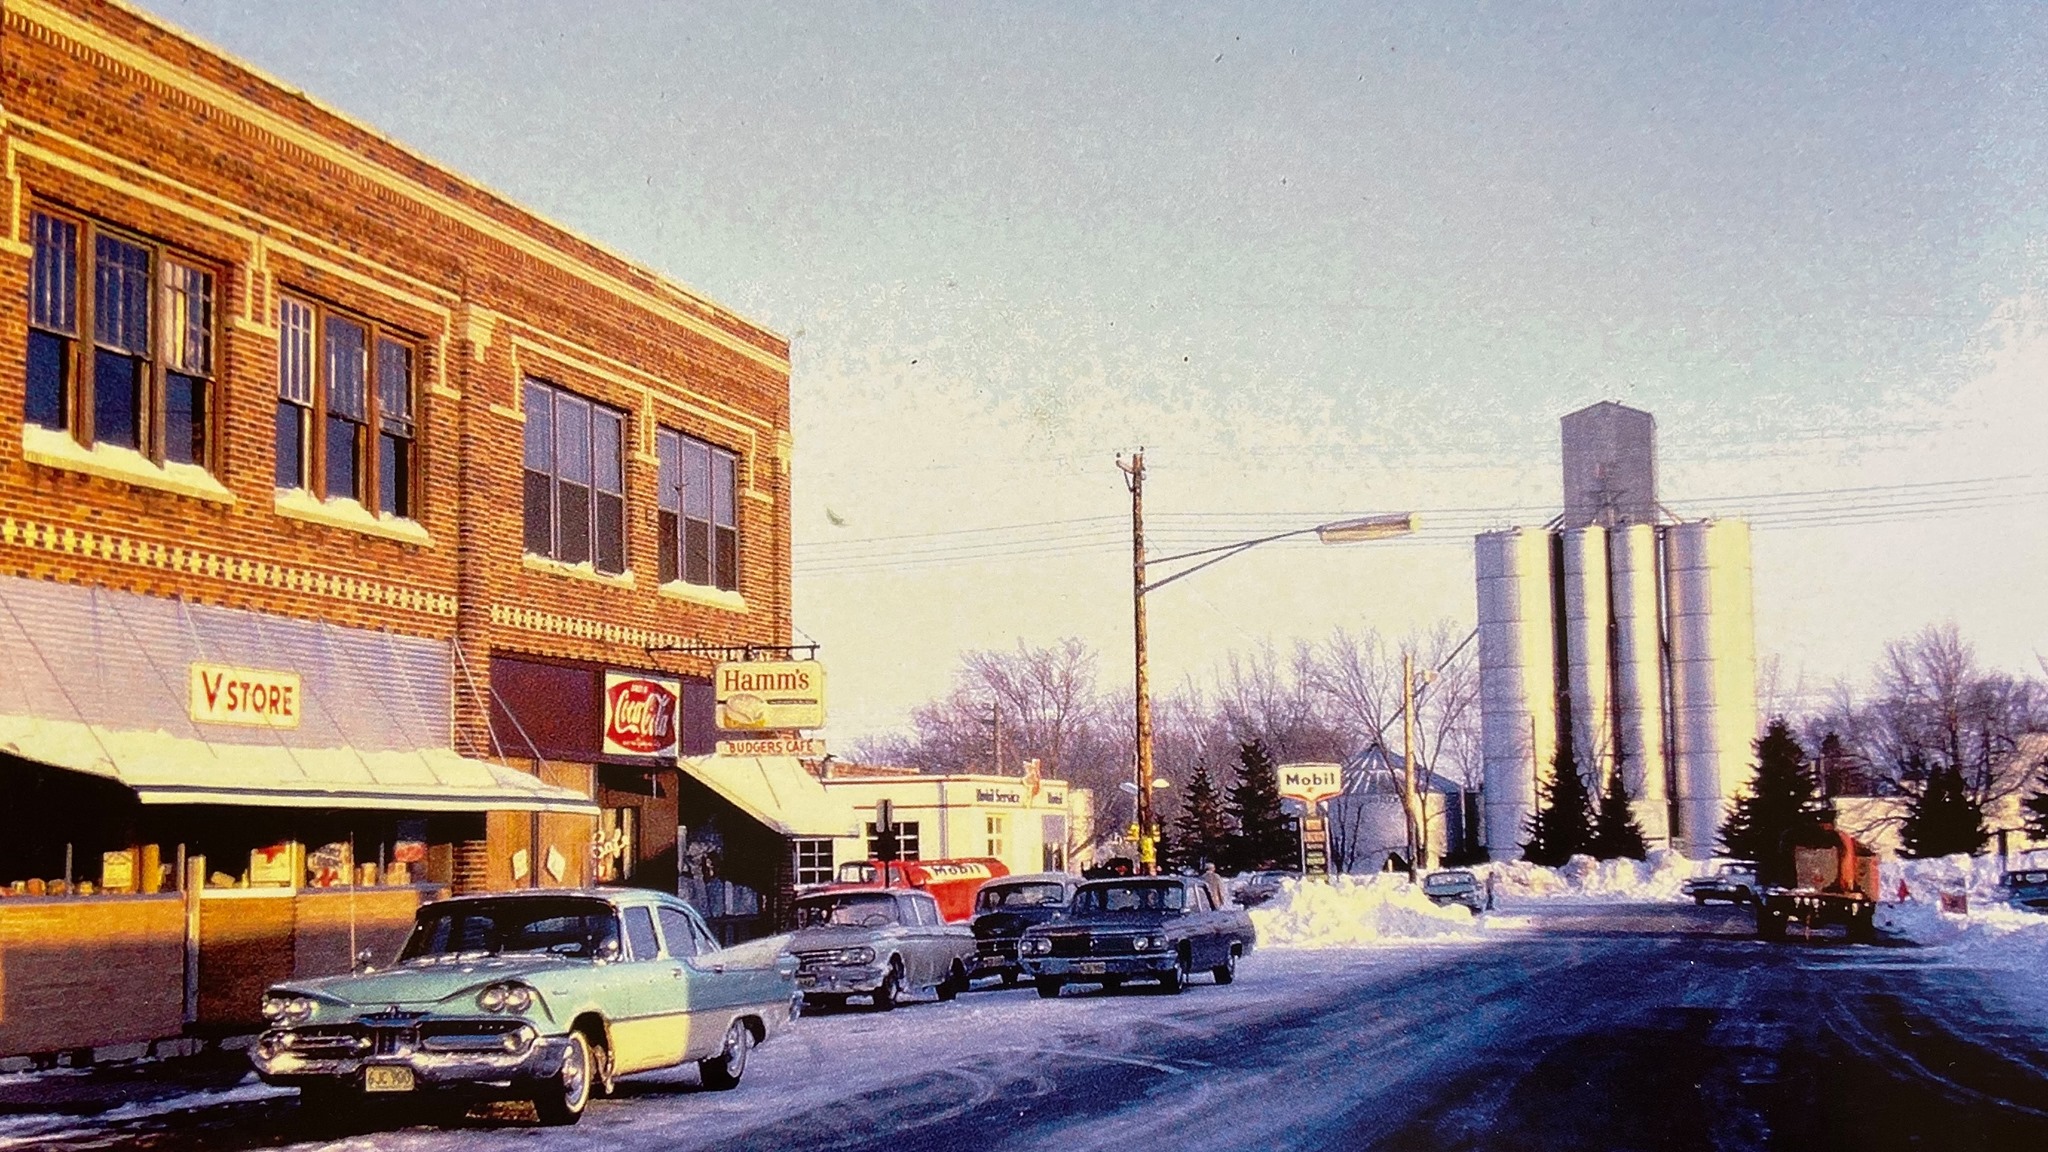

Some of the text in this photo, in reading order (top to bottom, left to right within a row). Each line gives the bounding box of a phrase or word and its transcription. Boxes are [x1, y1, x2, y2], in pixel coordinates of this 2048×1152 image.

[724, 669, 809, 691] Hamm's
[201, 671, 293, 716] V STORE
[729, 741, 813, 754] BUDGERS CAFE
[1286, 773, 1335, 786] Mobil
[931, 864, 981, 876] Mobil
